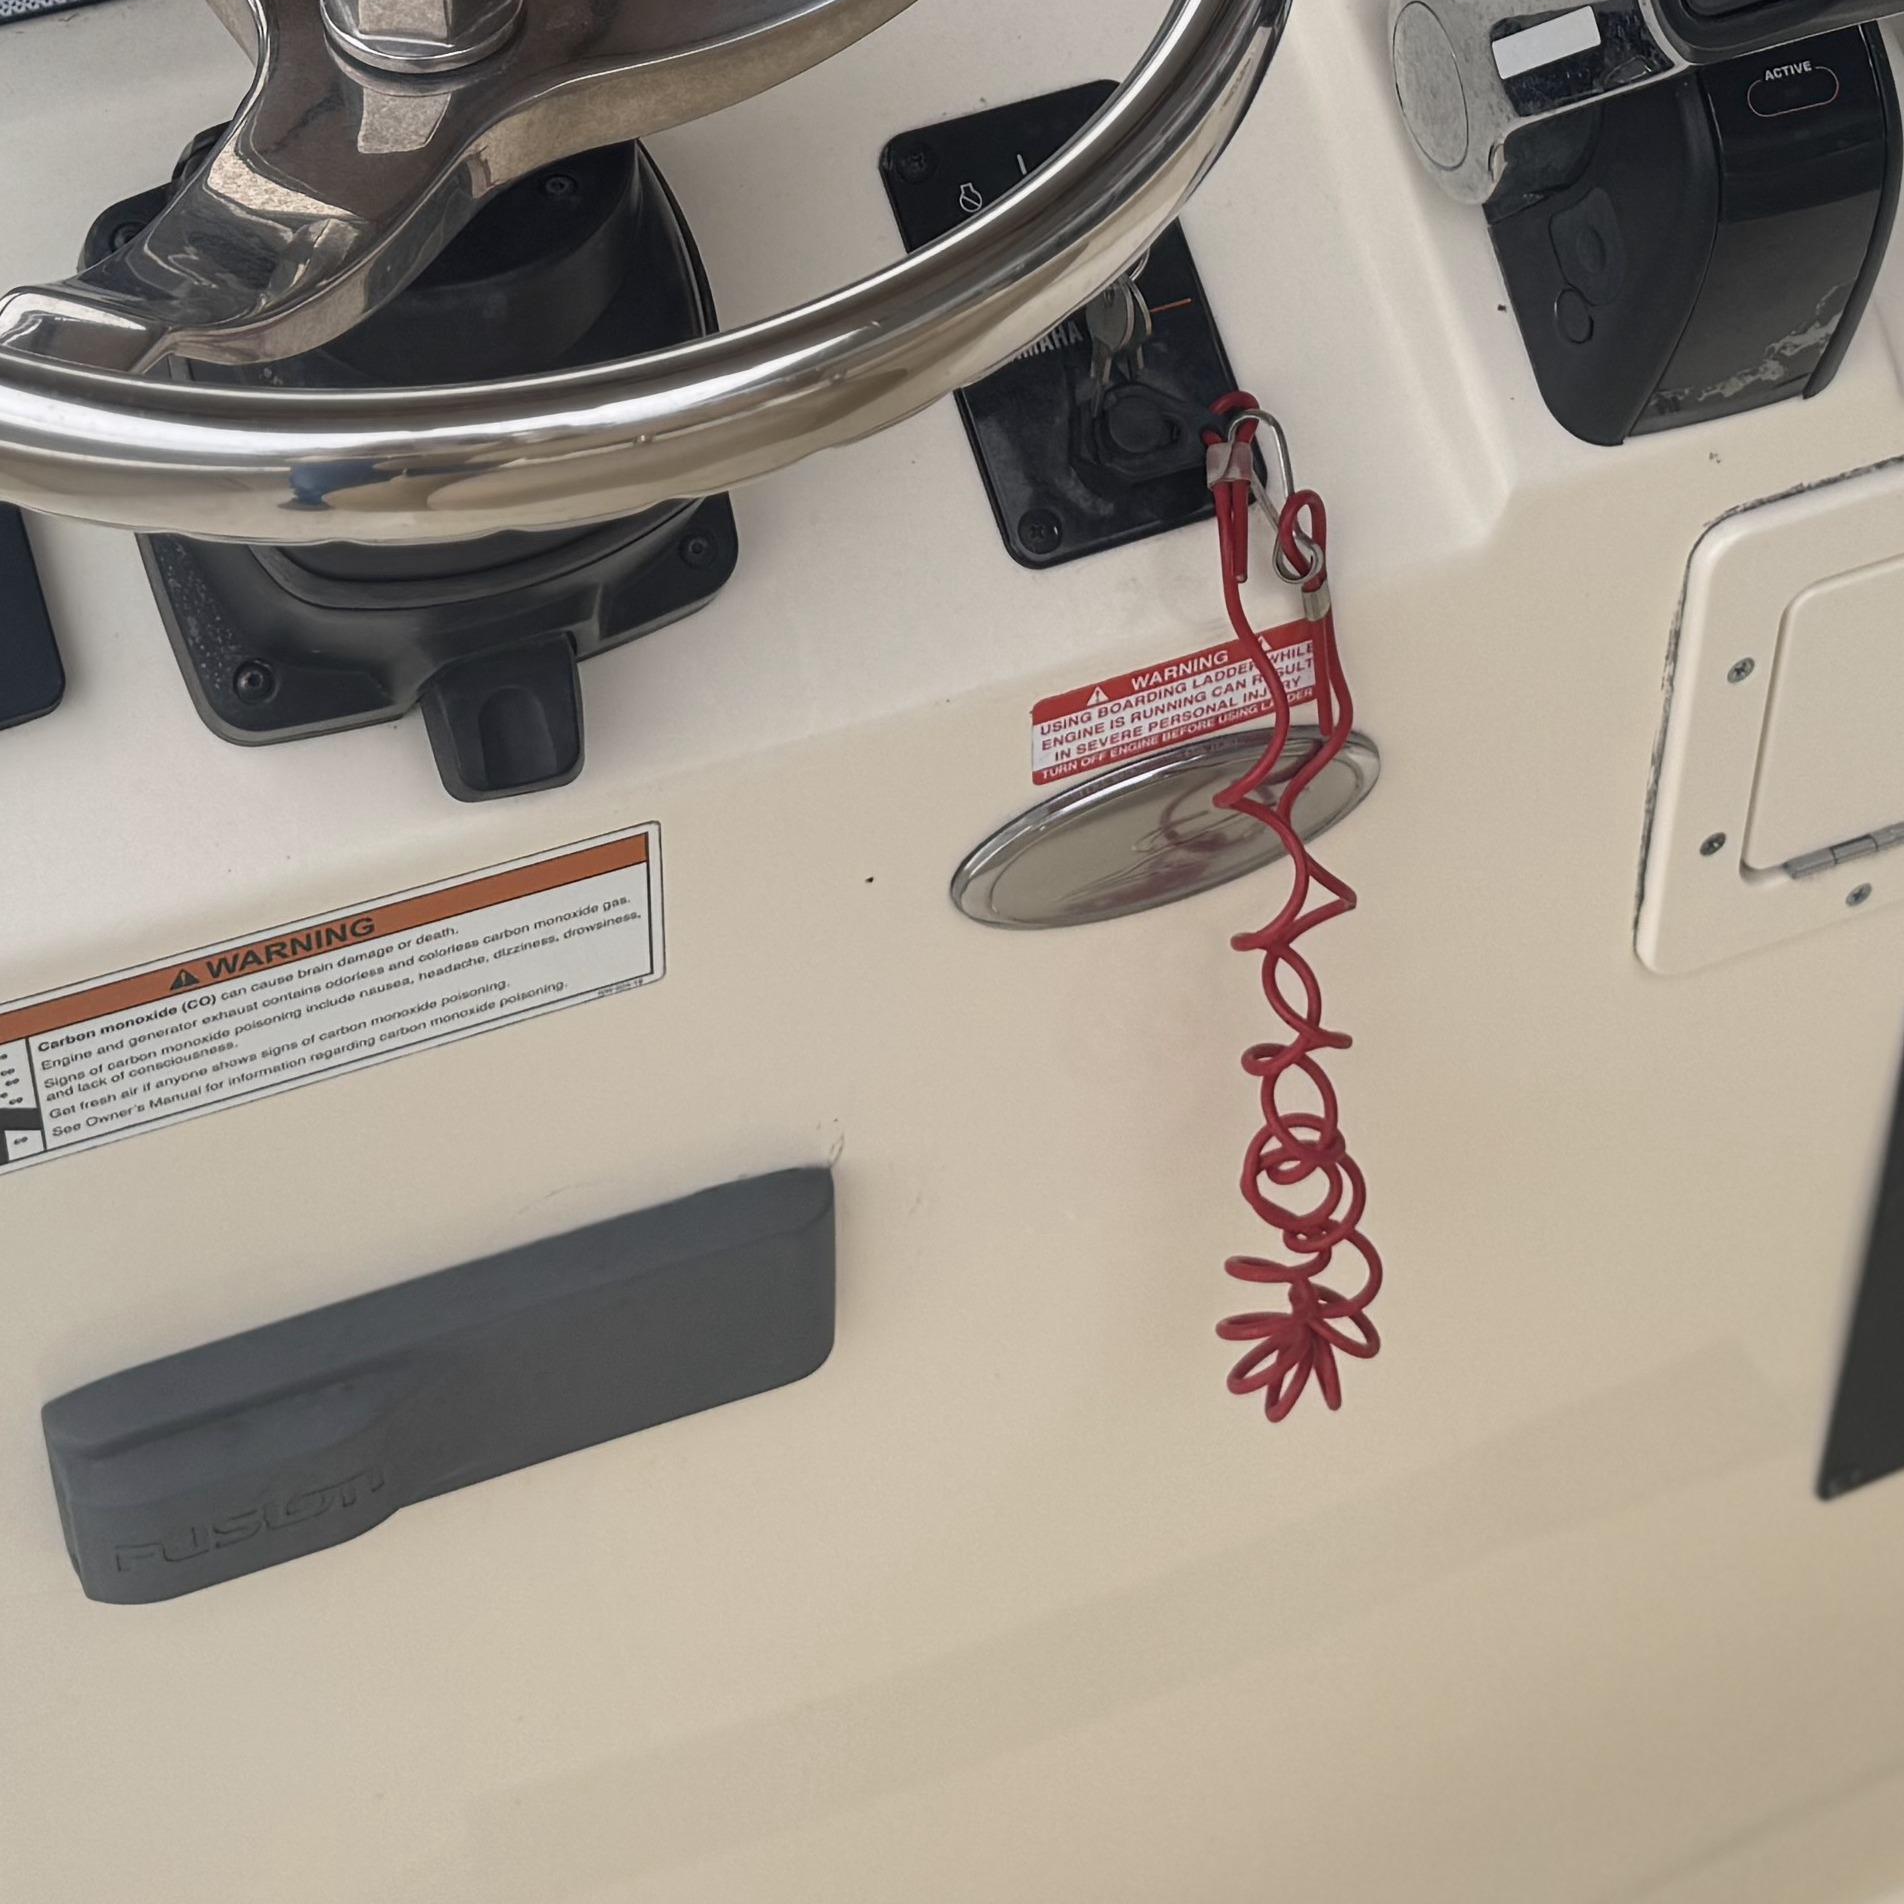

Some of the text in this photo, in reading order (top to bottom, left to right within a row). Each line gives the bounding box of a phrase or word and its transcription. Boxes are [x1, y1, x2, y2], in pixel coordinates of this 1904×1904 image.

[1764, 60, 1813, 81] ACTIVE
[1040, 711, 1092, 735] USING
[1097, 681, 1187, 718] BOARDING
[1041, 656, 1314, 751] ENGINE IS RUNNING CAN RSULT
[1131, 649, 1228, 691] WARNING
[1042, 759, 1077, 779] TURN
[1080, 751, 1105, 766] OFF
[1110, 734, 1157, 757] ENGINE
[1162, 718, 1213, 741] BEFORE
[1218, 704, 1257, 723] USING
[1054, 675, 1301, 761] IN SEVERE PERSONAL INJRY
[40, 1050, 92, 1071] Engine
[96, 1038, 124, 1055] and
[127, 1019, 197, 1048] generator
[201, 1000, 258, 1024] exhaust
[261, 984, 321, 1007] contains
[324, 966, 384, 989] odorless
[387, 954, 414, 971] and
[417, 939, 479, 963] colorless
[482, 924, 529, 944] carbon
[533, 903, 598, 930] monoxide
[205, 917, 374, 978] WARNING
[37, 1029, 96, 1052] Carbon
[99, 1006, 177, 1035] monoxide
[180, 993, 216, 1014] (CO)
[220, 986, 247, 1001] can
[250, 973, 293, 992] cause
[297, 962, 333, 979] brain
[335, 944, 394, 968] damage
[397, 939, 411, 950] or
[43, 1070, 85, 1088] Signs
[88, 1063, 102, 1076] of
[107, 1050, 157, 1071] carbon
[160, 1029, 230, 1055] monoxide
[234, 1008, 302, 1037] poisoning
[305, 993, 355, 1013] include
[48, 1104, 76, 1119] Get
[79, 1093, 116, 1110] fresh
[120, 1086, 138, 1099] air
[142, 1081, 150, 1092] if
[154, 1067, 208, 1089] anyone
[211, 1053, 257, 1072] shows
[260, 1041, 298, 1058] signs
[300, 1033, 315, 1046] of
[317, 1021, 366, 1041] carbon
[370, 999, 437, 1026] monoxide
[51, 1122, 81, 1137] See
[85, 1103, 145, 1127] Owner's
[148, 1085, 201, 1109] Manual
[204, 1080, 223, 1092] for
[227, 1056, 306, 1086] information
[309, 1036, 375, 1062] regarding
[378, 1021, 426, 1042] carbon
[429, 1000, 495, 1026] monoxide
[45, 1084, 73, 1102] and
[77, 1077, 107, 1092] lack
[110, 1070, 124, 1083] of
